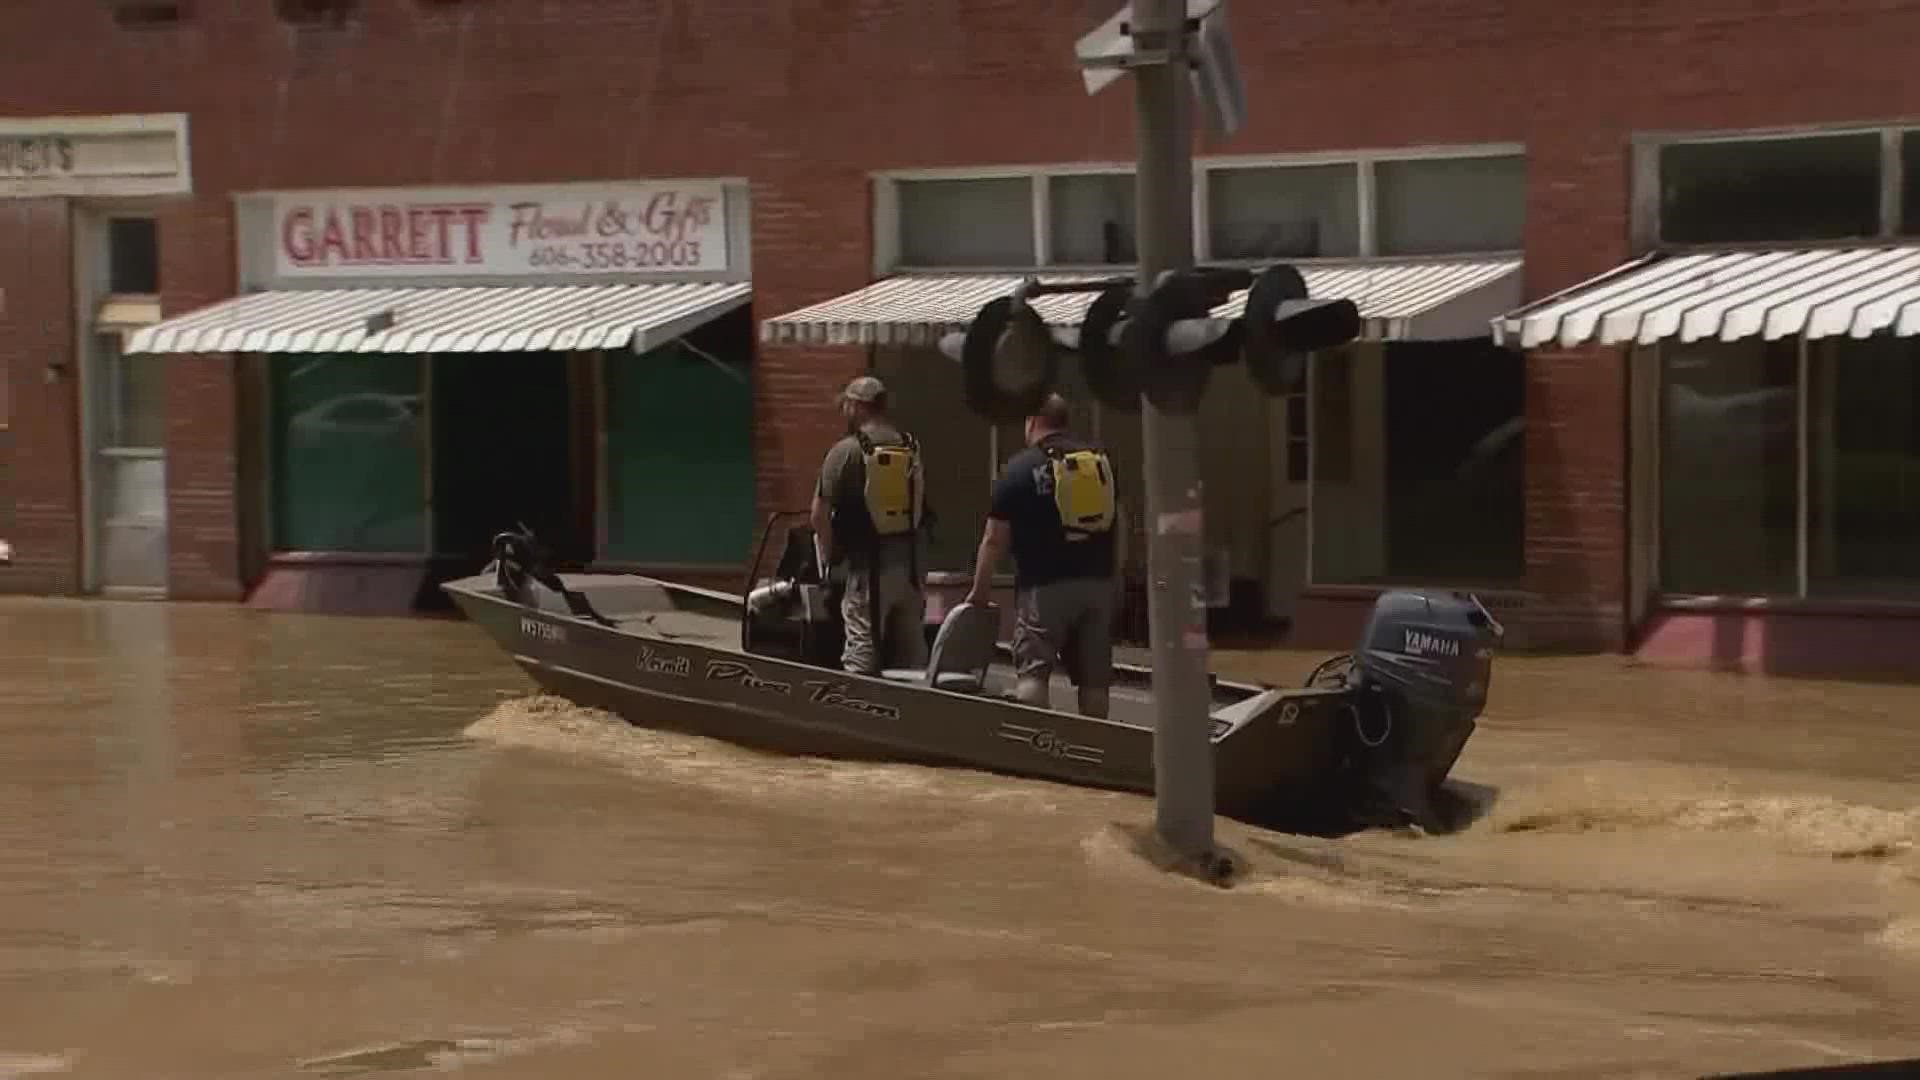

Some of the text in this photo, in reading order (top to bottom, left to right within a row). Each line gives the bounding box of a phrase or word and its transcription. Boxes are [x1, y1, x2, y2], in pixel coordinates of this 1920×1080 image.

[282, 202, 493, 266] GARRETT
[597, 199, 632, 236] &
[529, 240, 702, 269] 606-358-2003
[1404, 628, 1460, 657] YAMAHA
[802, 679, 902, 720] Team
